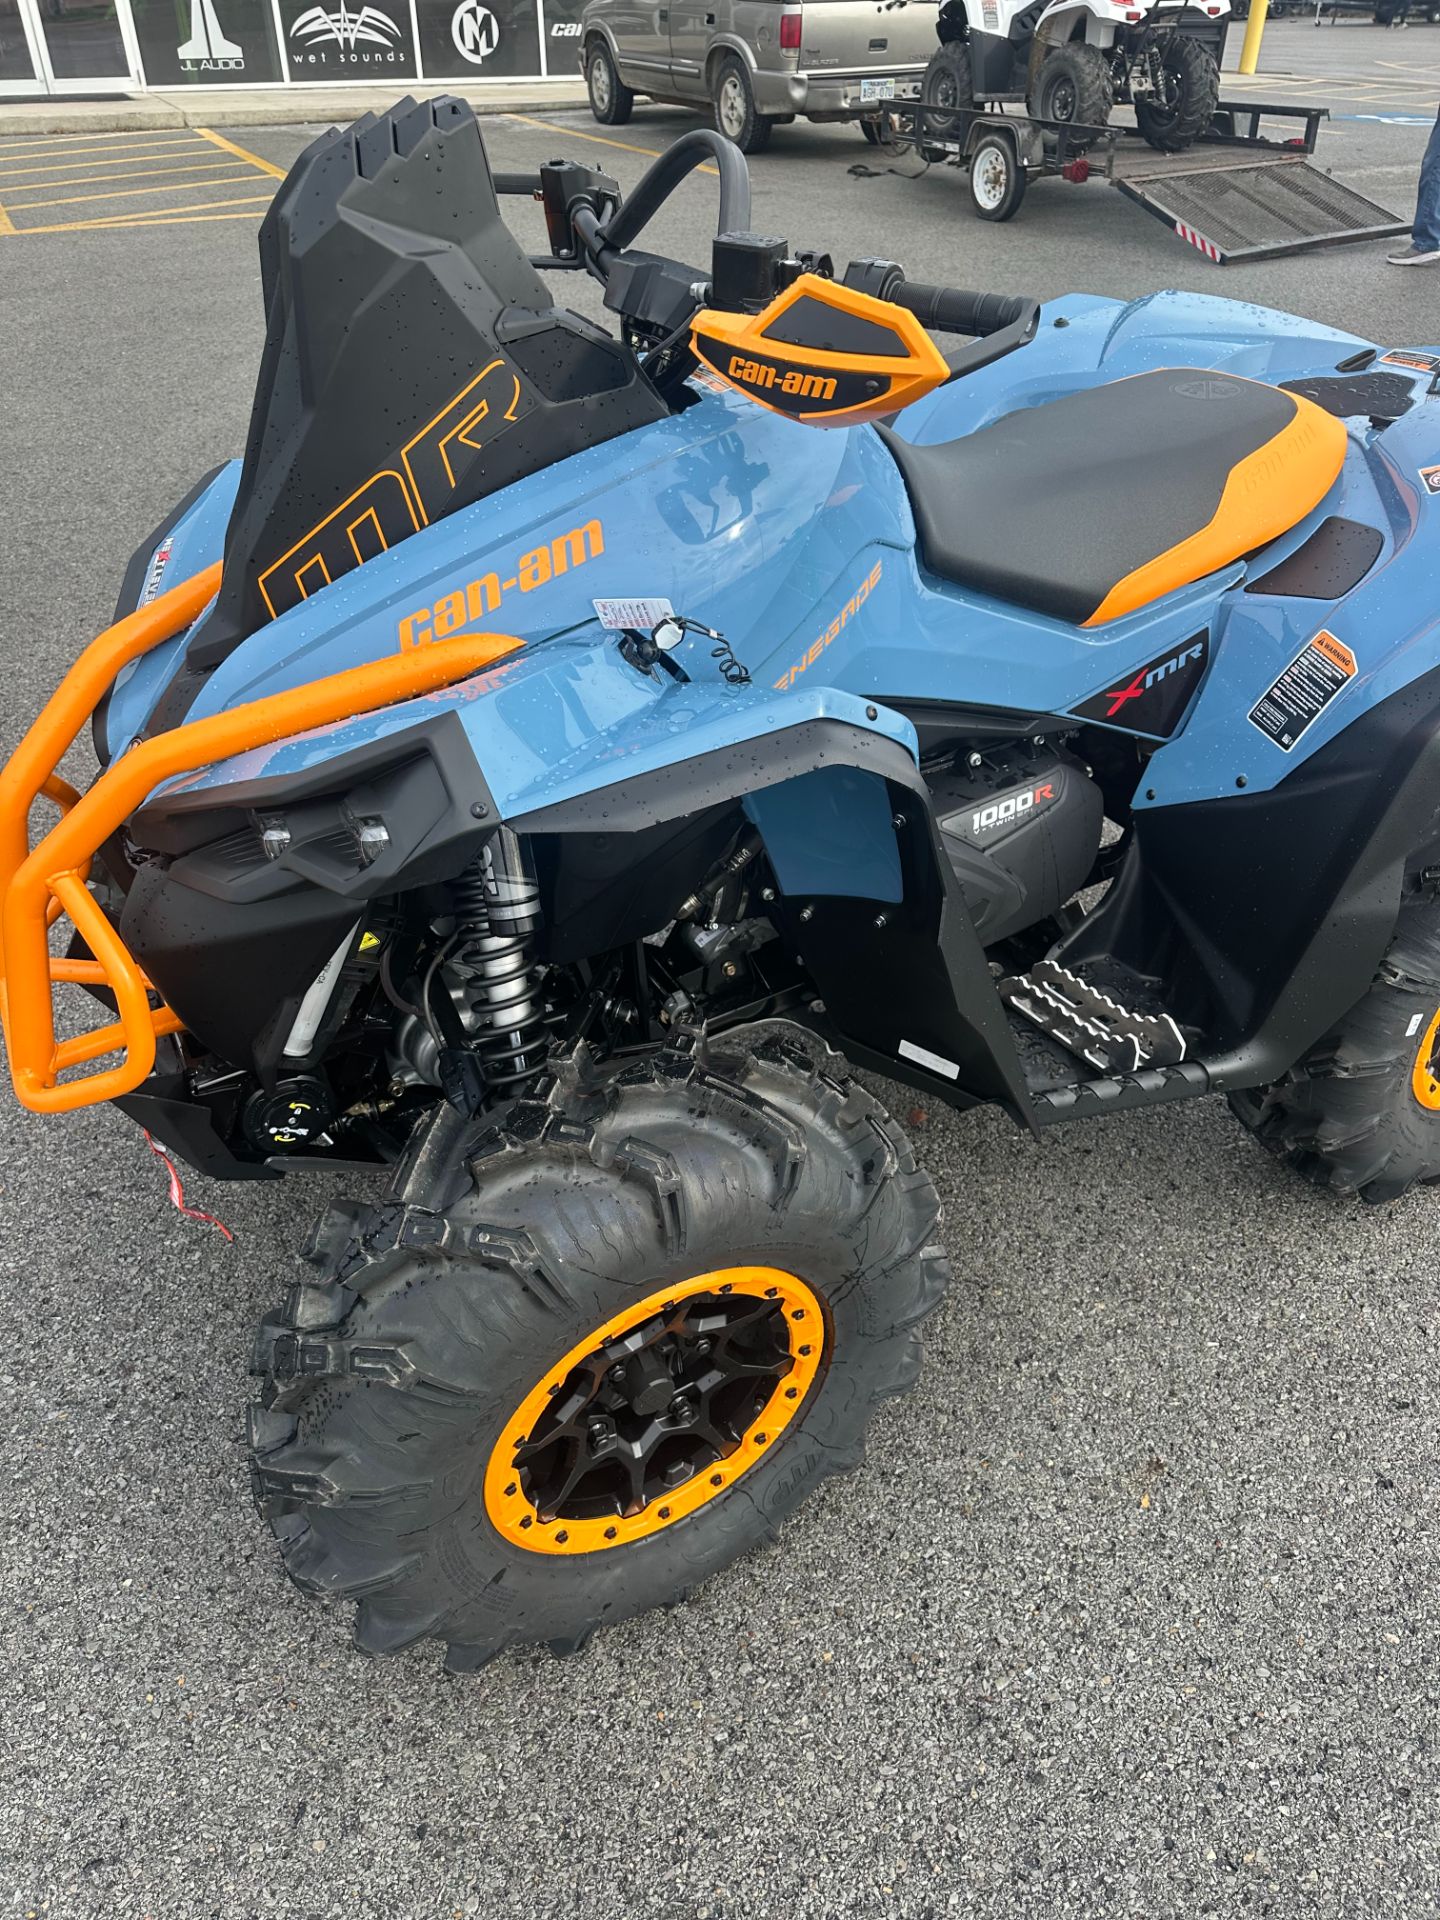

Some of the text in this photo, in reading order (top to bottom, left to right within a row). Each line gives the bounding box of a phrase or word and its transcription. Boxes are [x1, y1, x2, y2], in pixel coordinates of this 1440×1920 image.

[180, 58, 245, 71] JL AUDIO
[293, 51, 405, 64] wet sounds
[728, 355, 837, 400] can-am
[398, 519, 605, 652] can-am
[1324, 643, 1351, 667] WARNING
[972, 784, 1055, 830] 1000R
